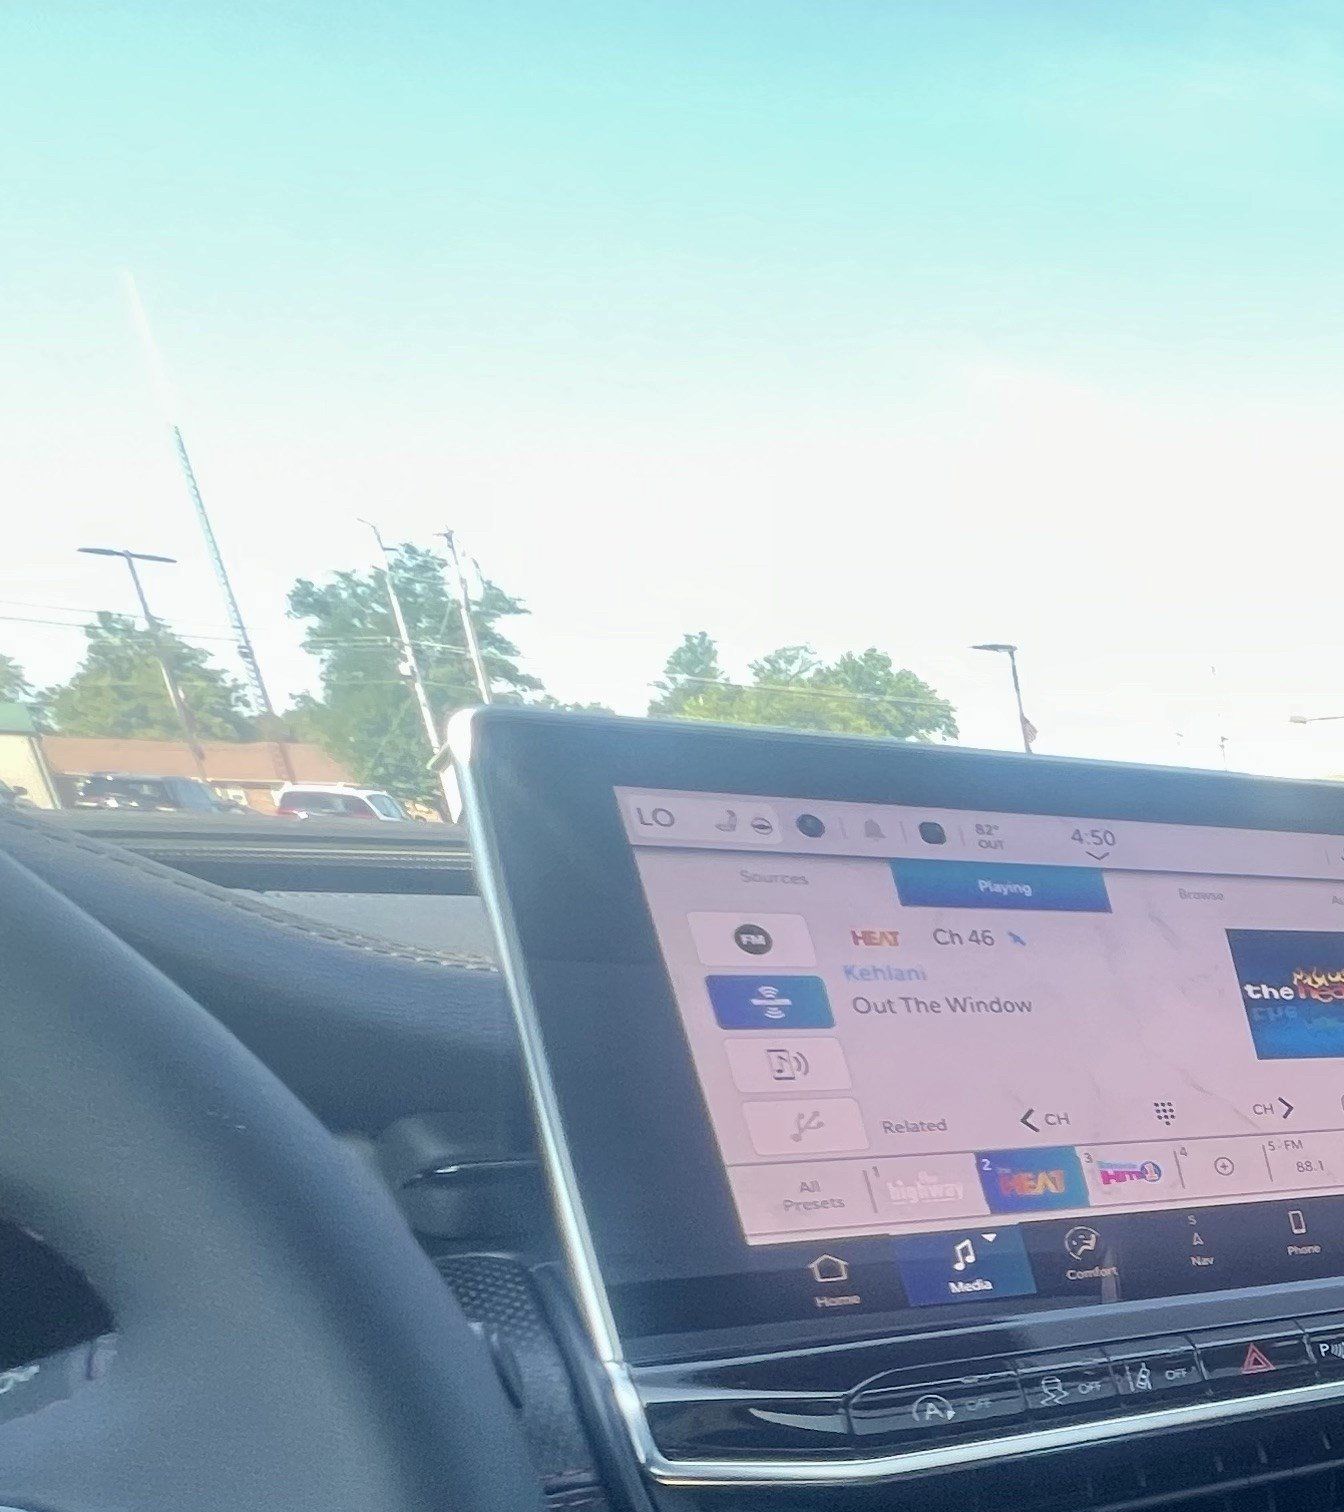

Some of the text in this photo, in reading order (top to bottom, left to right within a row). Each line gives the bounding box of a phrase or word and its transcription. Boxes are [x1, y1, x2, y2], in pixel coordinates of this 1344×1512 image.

[637, 806, 675, 828] LO
[978, 839, 1004, 850] OUT
[1070, 829, 1116, 847] 4:50
[740, 869, 810, 887] Sources
[977, 879, 1033, 898] Playing
[1178, 889, 1224, 902] Browse
[740, 934, 766, 946] FM
[851, 930, 900, 947] HEAT
[932, 928, 995, 947] Ch 46
[843, 964, 927, 982] Kehlani
[1243, 983, 1295, 1001] the
[852, 995, 1033, 1015] Out The Window
[1253, 1102, 1274, 1116] CH
[882, 1118, 948, 1135] Related
[1045, 1112, 1070, 1127] CH
[982, 1159, 992, 1171] 2
[1084, 1153, 1093, 1164] 3
[1296, 1160, 1324, 1173] 88.1
[800, 1180, 820, 1193] All
[783, 1198, 845, 1212] Presets
[1287, 1245, 1322, 1256] Phone
[1191, 1256, 1215, 1267] Nav
[1066, 1265, 1119, 1281] Comfort
[948, 1278, 994, 1295] Media
[814, 1295, 862, 1308] Home
